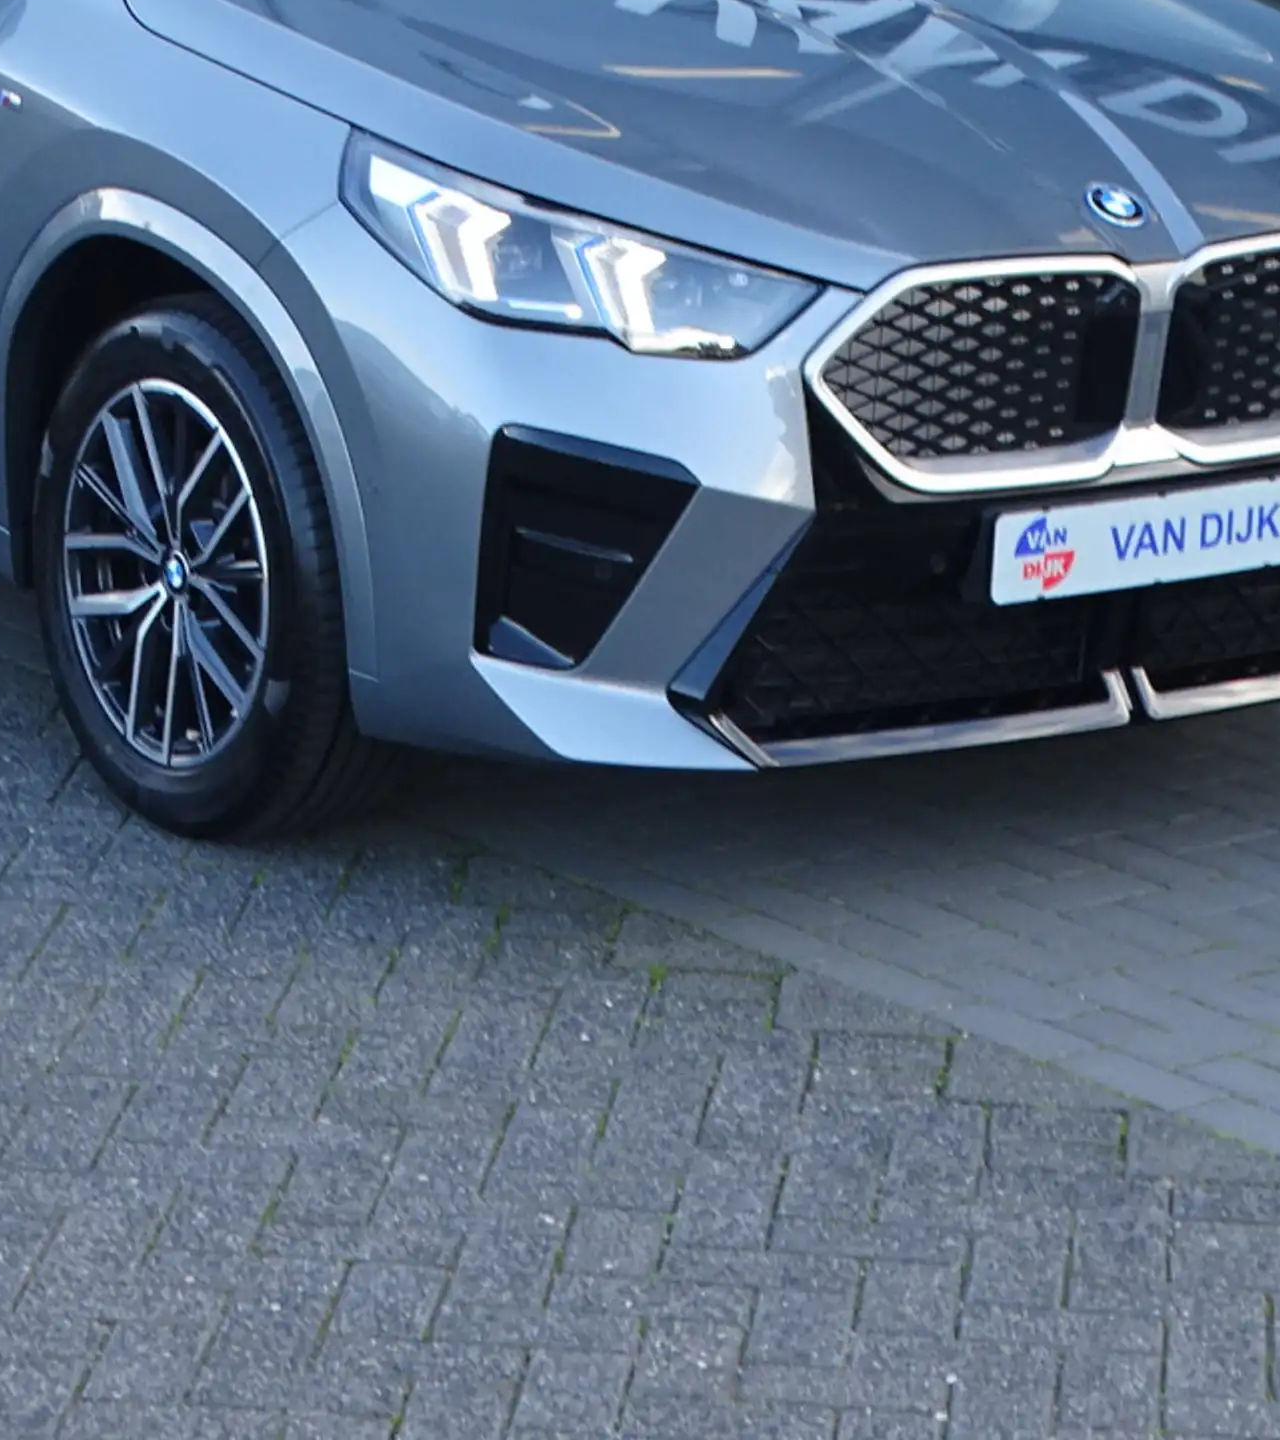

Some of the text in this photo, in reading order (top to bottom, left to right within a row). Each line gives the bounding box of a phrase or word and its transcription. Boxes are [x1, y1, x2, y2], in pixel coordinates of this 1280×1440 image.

[1026, 524, 1068, 551] VAN
[1111, 502, 1279, 561] VAN DIJK
